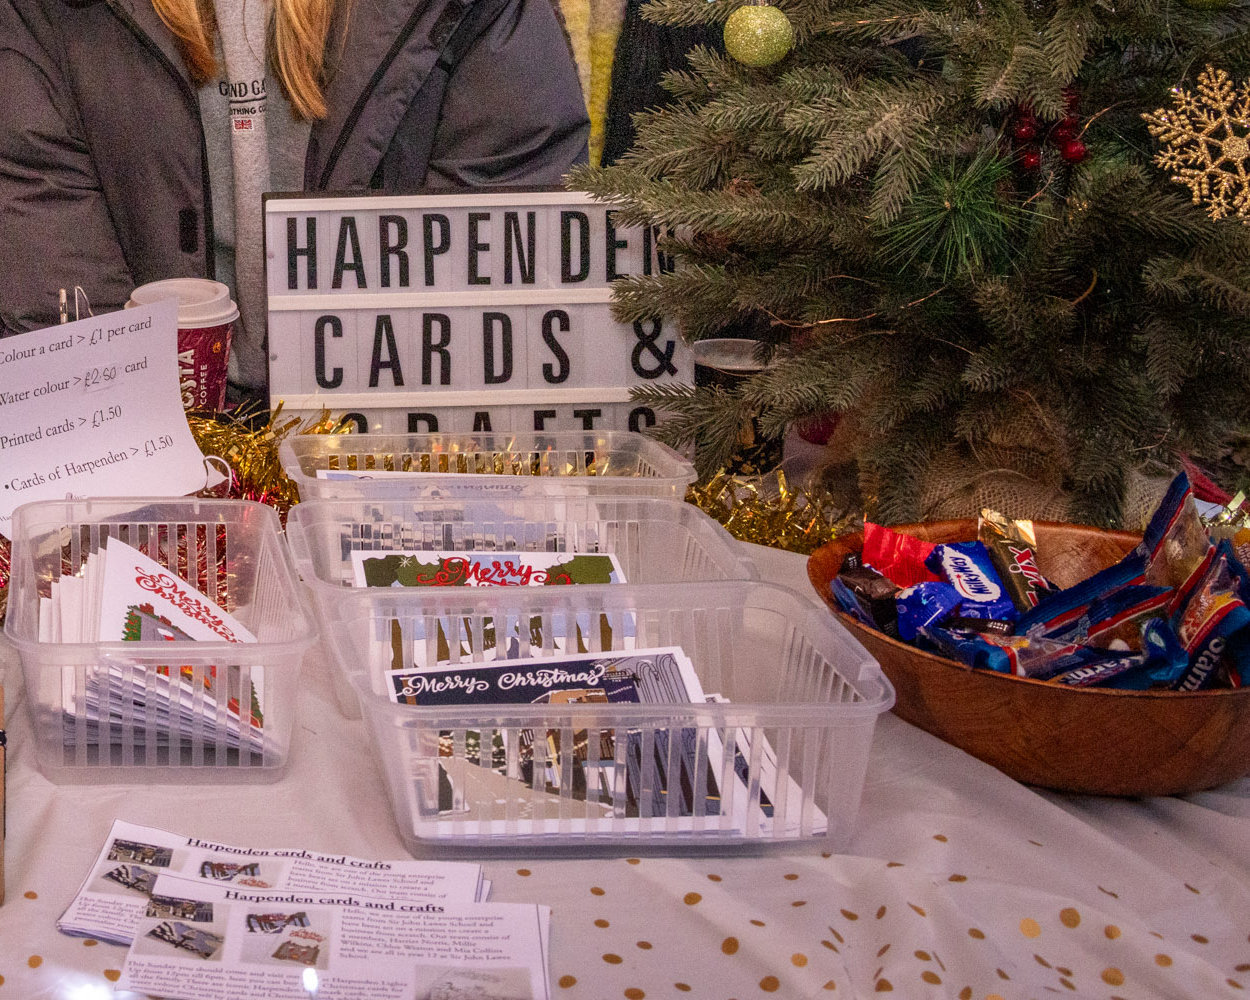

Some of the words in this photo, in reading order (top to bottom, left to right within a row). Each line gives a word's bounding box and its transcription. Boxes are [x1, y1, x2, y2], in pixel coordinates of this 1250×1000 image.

[39, 347, 45, 355] a
[48, 335, 73, 352] card
[89, 328, 103, 346] £1
[107, 327, 126, 342] per
[128, 317, 152, 333] card
[314, 309, 571, 389] CARDS
[631, 318, 679, 379] &
[33, 378, 70, 397] colour
[124, 357, 148, 373] card
[178, 348, 197, 409] OSTA
[199, 364, 208, 405] COFFEE
[0, 426, 42, 450] Printed
[46, 418, 75, 437] cards
[92, 405, 122, 428] £1.50
[11, 475, 46, 492] Cards
[48, 466, 62, 481] of
[64, 450, 128, 476] Harpenden
[144, 435, 174, 457] £1.50
[417, 557, 551, 584] Merry
[135, 566, 235, 638] Merry
[135, 576, 243, 643] Christma
[400, 676, 489, 697] Merry
[498, 664, 606, 686] Christmas
[187, 838, 269, 857] Harpenden
[274, 849, 312, 859] cards
[317, 856, 346, 864] and
[350, 860, 391, 870] crafts
[225, 890, 314, 906] Harpenden
[319, 897, 360, 907] cards
[365, 901, 394, 910] and
[400, 903, 445, 913] crafts
